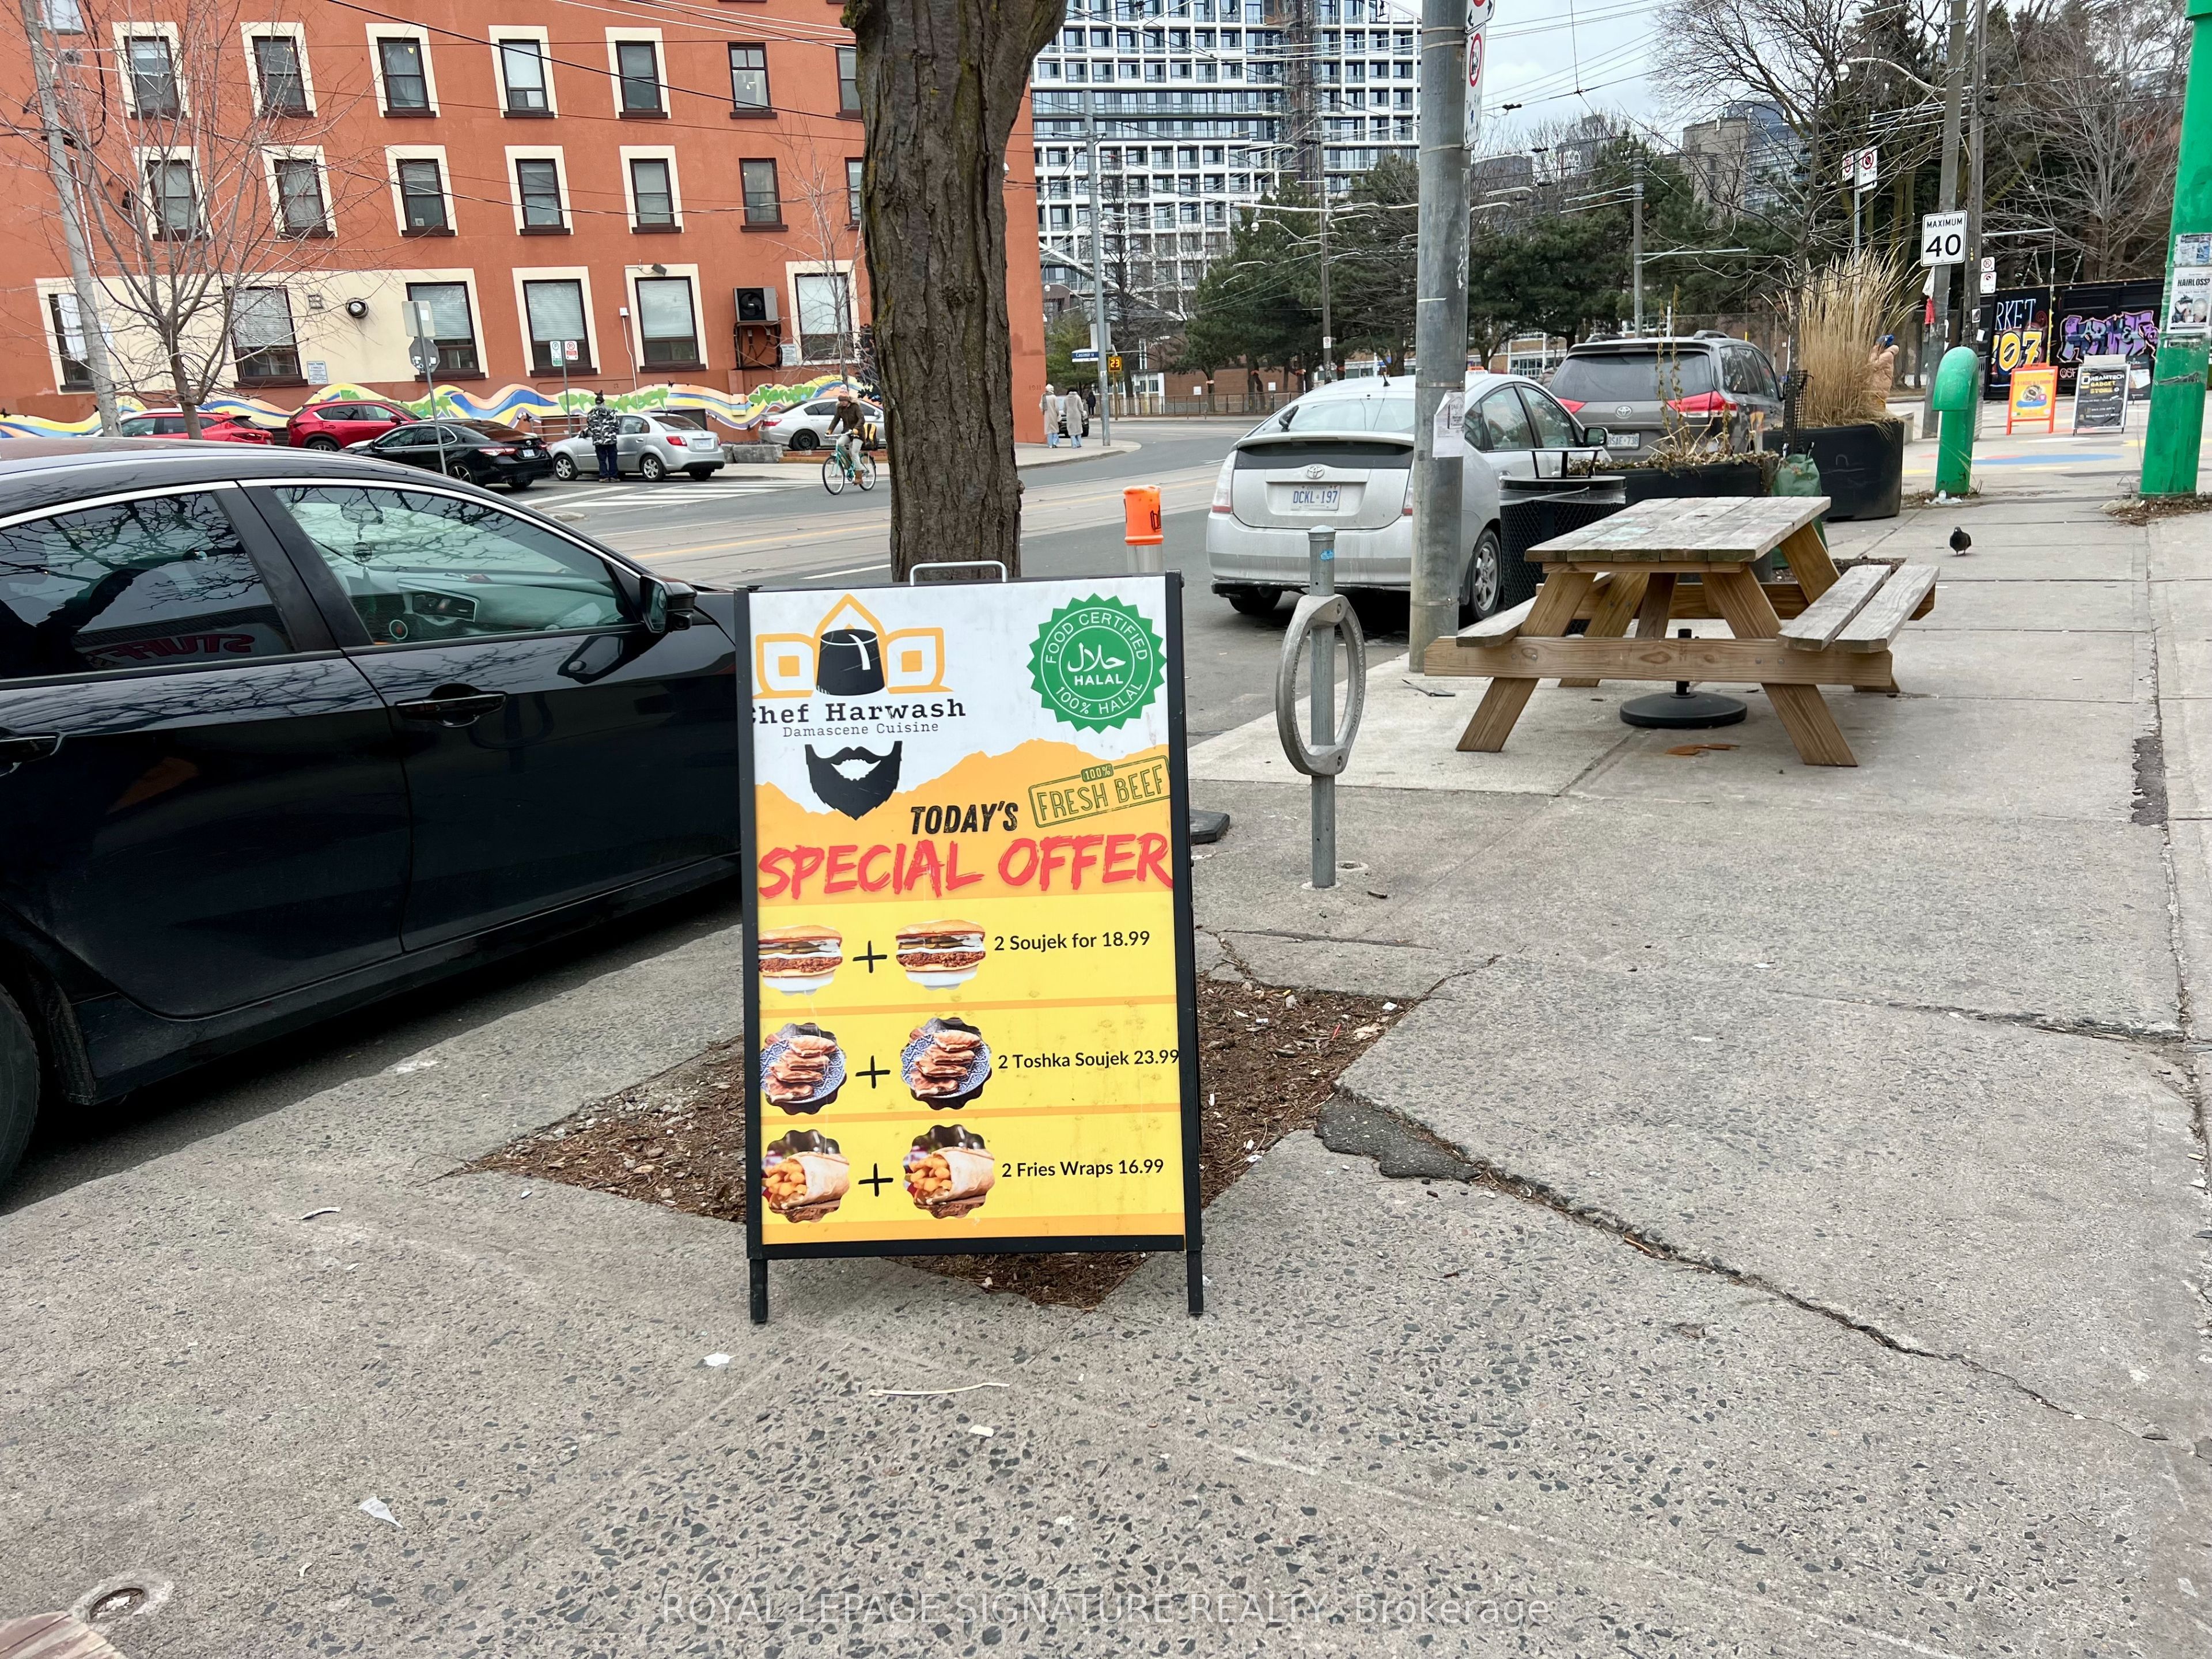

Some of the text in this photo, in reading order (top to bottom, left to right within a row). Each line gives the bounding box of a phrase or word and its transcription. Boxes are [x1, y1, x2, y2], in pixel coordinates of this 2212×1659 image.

[1927, 218, 1962, 228] MAXIMUM
[1926, 234, 1961, 257] 40
[1110, 359, 1120, 368] 23
[1293, 490, 1338, 503] DCKL 197
[1046, 612, 1148, 664] FOOD CERTIFIED
[1067, 642, 1126, 672] حلال
[1074, 673, 1123, 685] HALAL
[1056, 683, 1143, 714] 100% HALAL
[825, 699, 966, 722] Harwash
[783, 722, 939, 737] Damascene Cuisine
[1084, 766, 1111, 780] 100%
[1037, 764, 1162, 821] FRESH BEEF
[911, 801, 1018, 835] TODAY'S
[757, 832, 1173, 900] SPECIAL OFFER
[994, 930, 1150, 953] 2 Soujek for 18.99
[998, 1049, 1179, 1070] 2 Toshka Soujek 23.99
[1001, 1158, 1164, 1179] 2 Fries Wraps 16.99
